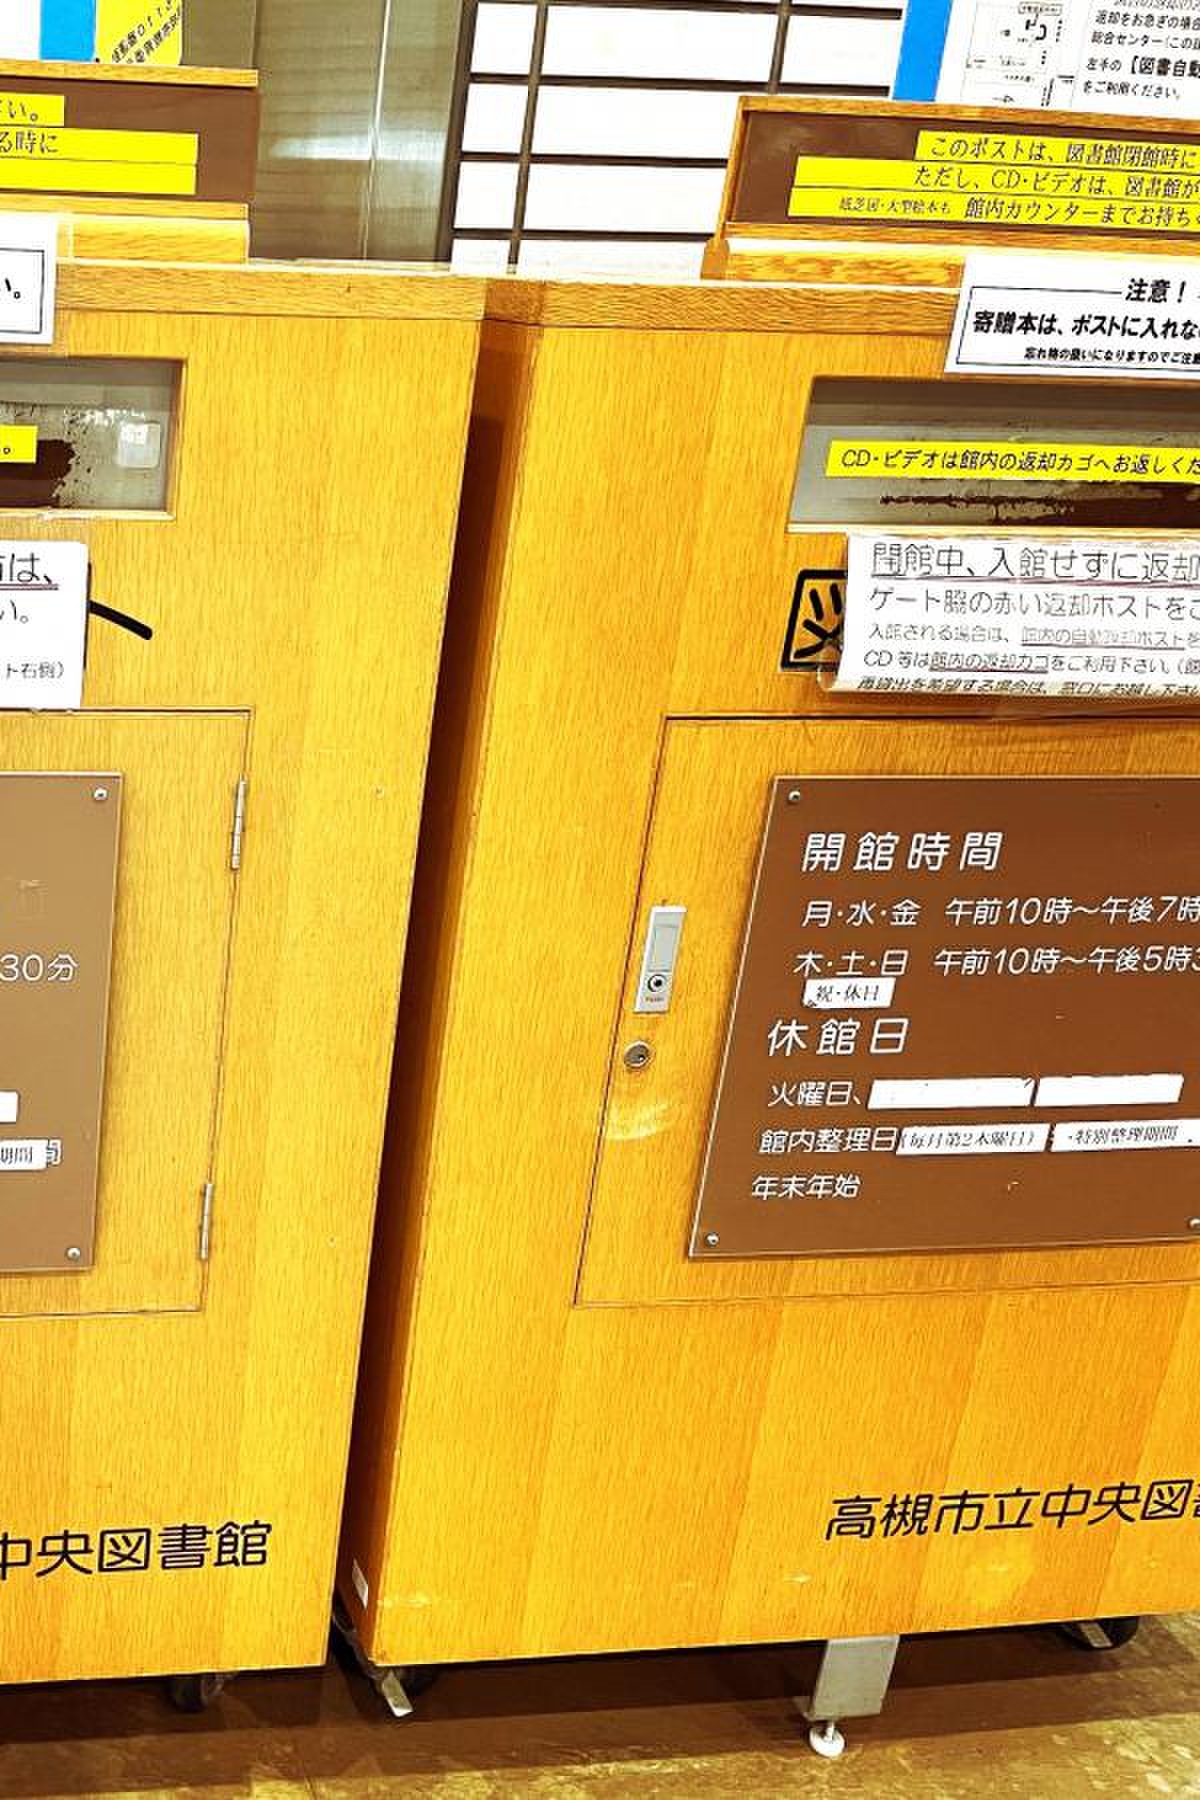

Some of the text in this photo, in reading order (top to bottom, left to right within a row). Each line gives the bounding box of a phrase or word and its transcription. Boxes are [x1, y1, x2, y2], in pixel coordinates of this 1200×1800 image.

[964, 198, 1200, 227] 館内カウンターまでお持ち
[1125, 278, 1186, 303] 注意！
[973, 310, 1200, 340] 寄贈本は、ポストに入れな
[872, 543, 1200, 583] 開館中、入館せずに返却
[803, 831, 1003, 871] 開館時間
[802, 899, 921, 927] 月・水・金
[793, 950, 908, 978] 木・土・日
[768, 1018, 909, 1057] 休館日
[758, 1128, 898, 1154] 館内整理日
[751, 1174, 860, 1200] 年末年始
[825, 1478, 1200, 1540] 高槻市立中央図
